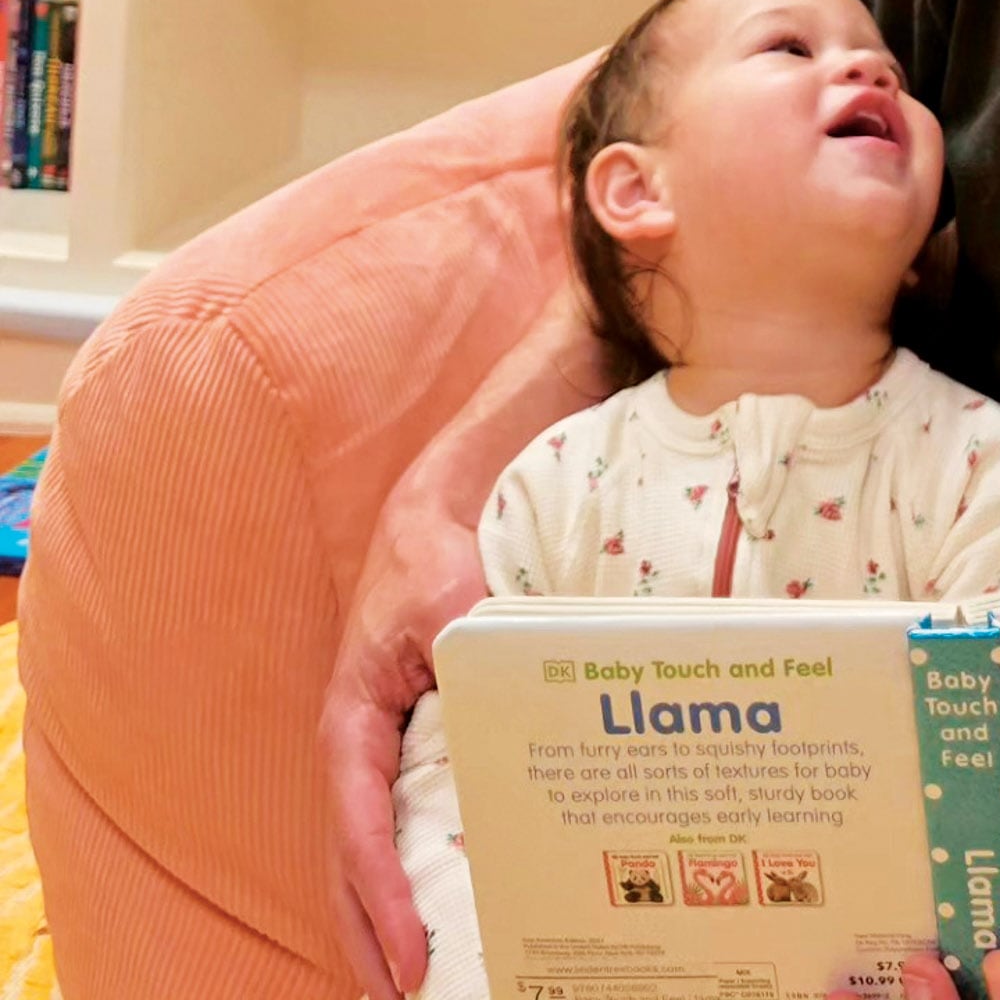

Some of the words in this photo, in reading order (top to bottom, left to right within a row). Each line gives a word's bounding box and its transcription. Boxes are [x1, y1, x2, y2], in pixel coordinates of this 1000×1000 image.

[584, 661, 645, 684] Baby
[652, 660, 720, 679] Touch
[729, 658, 775, 678] and
[783, 657, 833, 677] Feel
[926, 670, 992, 693] Baby
[600, 690, 782, 735] Llama
[924, 697, 998, 717] Touch
[940, 722, 990, 741] and
[528, 743, 575, 758] From
[580, 741, 621, 761] furry
[627, 744, 668, 758] ears
[673, 742, 690, 757] to
[696, 740, 766, 759] squishy
[772, 740, 865, 758] footprints,
[941, 749, 994, 768] Feel
[528, 764, 575, 781] there
[580, 768, 611, 781] are
[616, 763, 638, 780] all
[643, 765, 688, 780] sorts
[692, 763, 710, 780] of
[716, 763, 789, 779] textures
[794, 762, 819, 779] for
[824, 761, 872, 781] baby
[548, 789, 566, 803] to
[571, 787, 640, 806] explore
[645, 786, 661, 802] in
[667, 785, 699, 802] this
[704, 785, 743, 804] soft,
[749, 784, 805, 805] sturdy
[810, 784, 858, 801] book
[562, 810, 596, 825] that
[602, 811, 712, 828] encourages
[716, 808, 762, 827] early
[767, 808, 844, 828] learning
[669, 834, 694, 844] Also
[698, 833, 726, 844] from
[729, 834, 747, 844] DK
[964, 849, 1000, 951] Llama
[849, 976, 895, 987] $10.99
